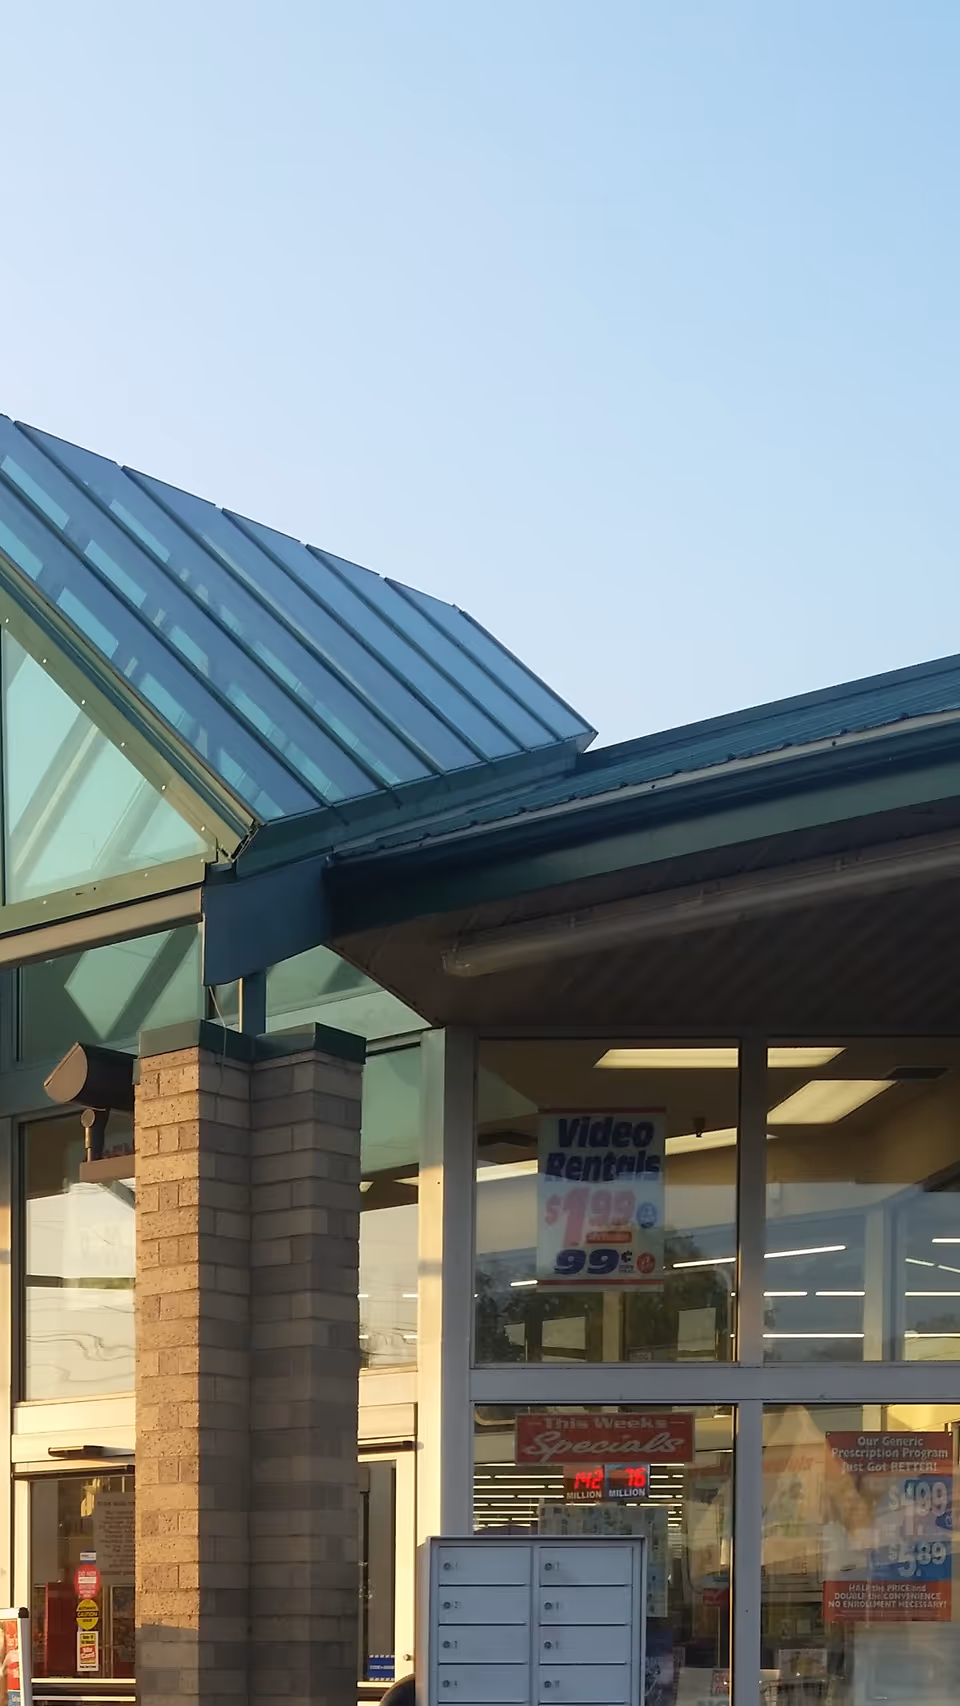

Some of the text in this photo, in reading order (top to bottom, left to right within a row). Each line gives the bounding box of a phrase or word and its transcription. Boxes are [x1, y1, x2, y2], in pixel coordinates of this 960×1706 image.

[558, 1116, 654, 1148] Video
[545, 1151, 661, 1182] Rentals
[544, 1417, 667, 1429] This Weeks
[858, 1436, 923, 1446] Our Generic
[522, 1431, 684, 1463] Specials
[832, 1448, 948, 1461] Prescription Program
[842, 1462, 937, 1474] Just Got BETTER!
[566, 1490, 603, 1499] MILLION
[609, 1487, 646, 1497] MILLION
[886, 1584, 910, 1592] PRICE
[834, 1592, 865, 1600] DOUBLE
[883, 1592, 941, 1600] CONVENIENCE
[828, 1600, 841, 1608] NO
